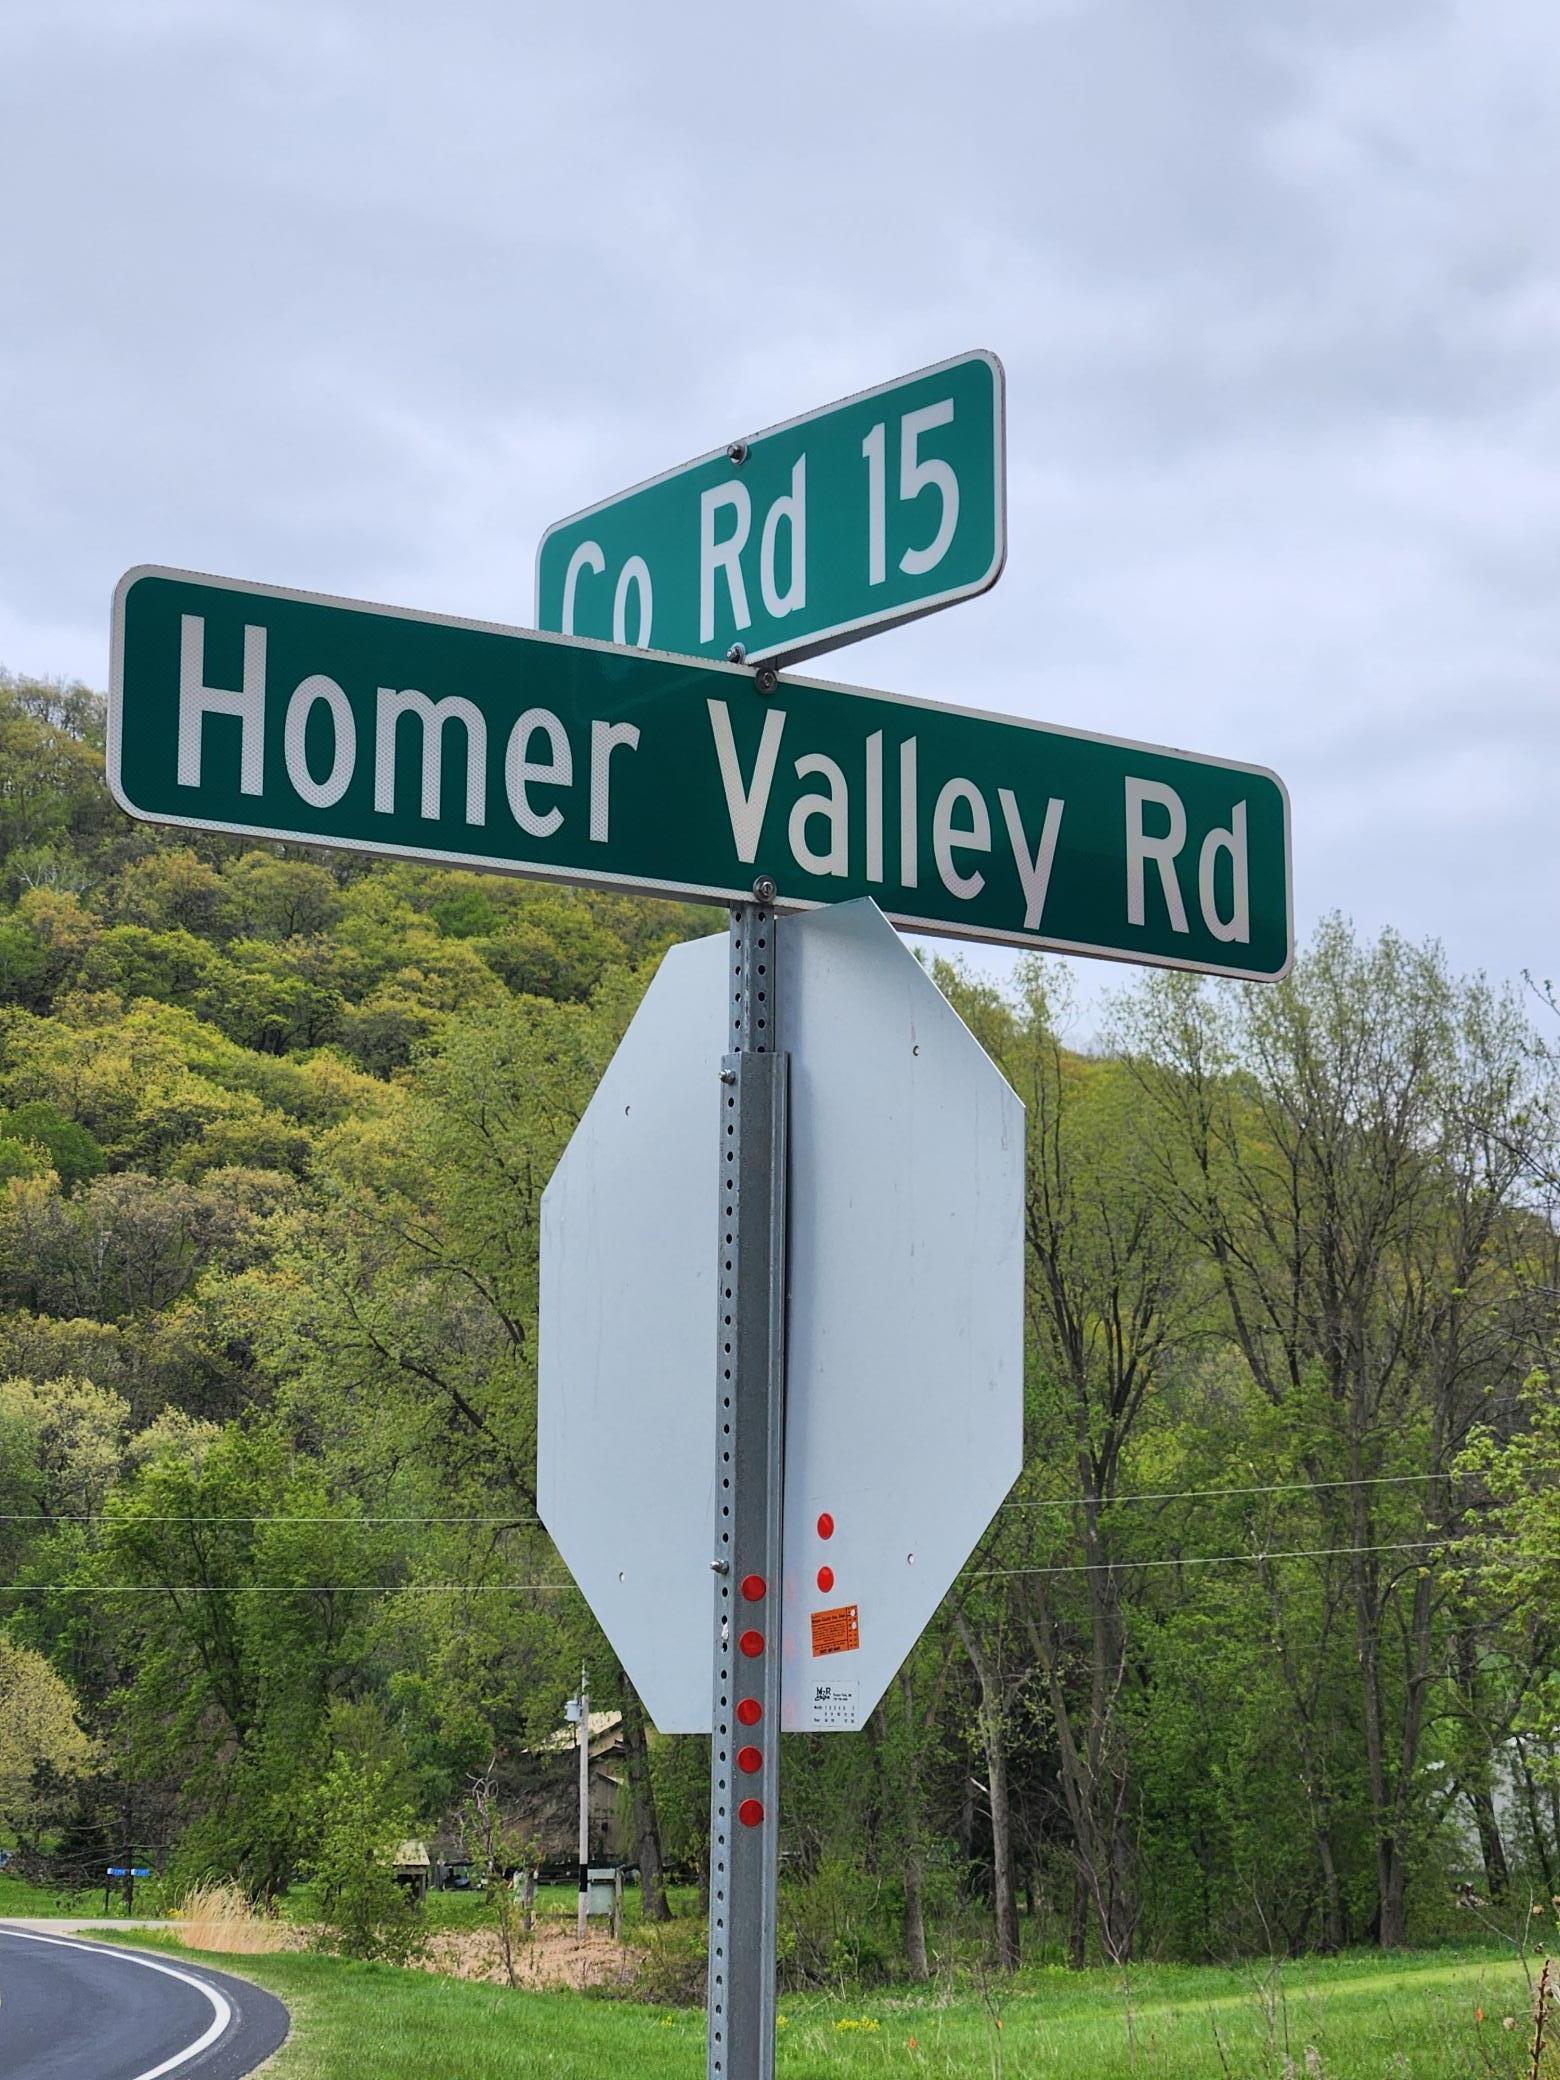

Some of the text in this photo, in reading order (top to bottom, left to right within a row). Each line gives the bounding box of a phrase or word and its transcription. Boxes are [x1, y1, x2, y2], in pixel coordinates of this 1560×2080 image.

[561, 399, 959, 650] Co Rd 15
[178, 615, 1249, 943] Homer Valley Rd
